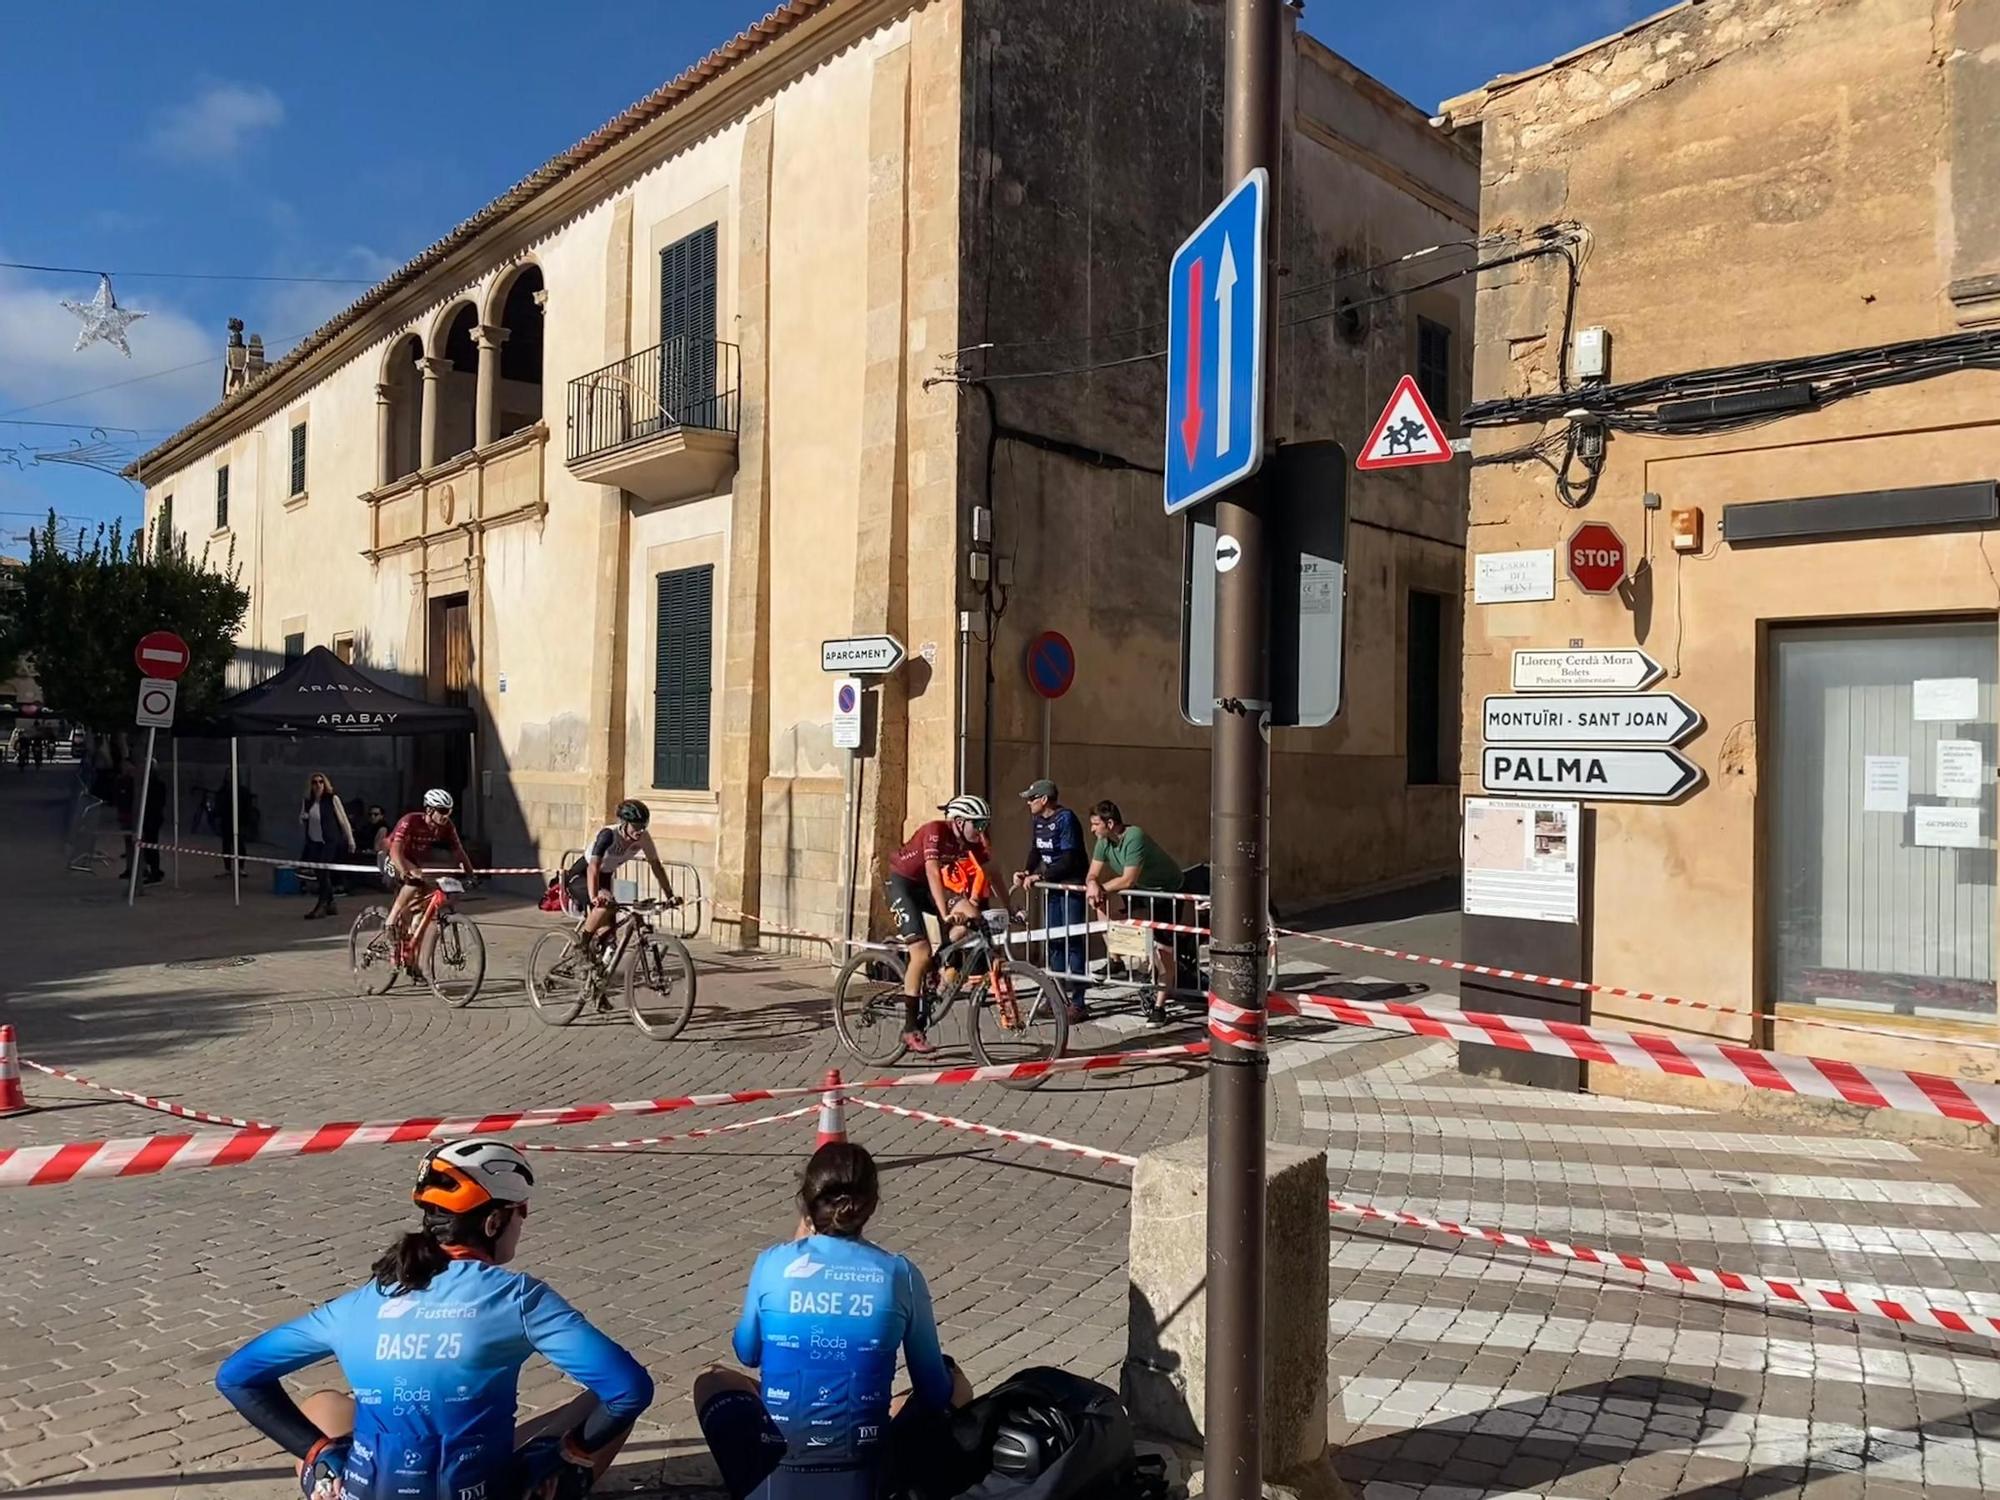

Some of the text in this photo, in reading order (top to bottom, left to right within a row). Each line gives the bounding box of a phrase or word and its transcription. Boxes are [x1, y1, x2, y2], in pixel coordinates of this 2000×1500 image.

[1574, 549, 1621, 567] STOP
[825, 649, 888, 661] APARCAMENT
[1520, 655, 1634, 667] Llorenç Cerdà Mora
[1561, 668, 1590, 676] Bolets
[298, 684, 374, 694] ARABAY
[316, 713, 398, 725] ARABAY
[1488, 708, 1563, 727] MONTUÏRI
[1578, 712, 1621, 727] SANT
[1625, 712, 1669, 727] JOAN
[1493, 756, 1609, 784] PALMA
[824, 1269, 885, 1284] Fusteria
[789, 1290, 875, 1317] BASE 25
[415, 1306, 478, 1320] Fusteria
[811, 1323, 825, 1335] Sa
[375, 1332, 463, 1361] BASE 25
[810, 1334, 848, 1349] Roda
[393, 1376, 408, 1387] Sa
[393, 1386, 431, 1402] Roda
